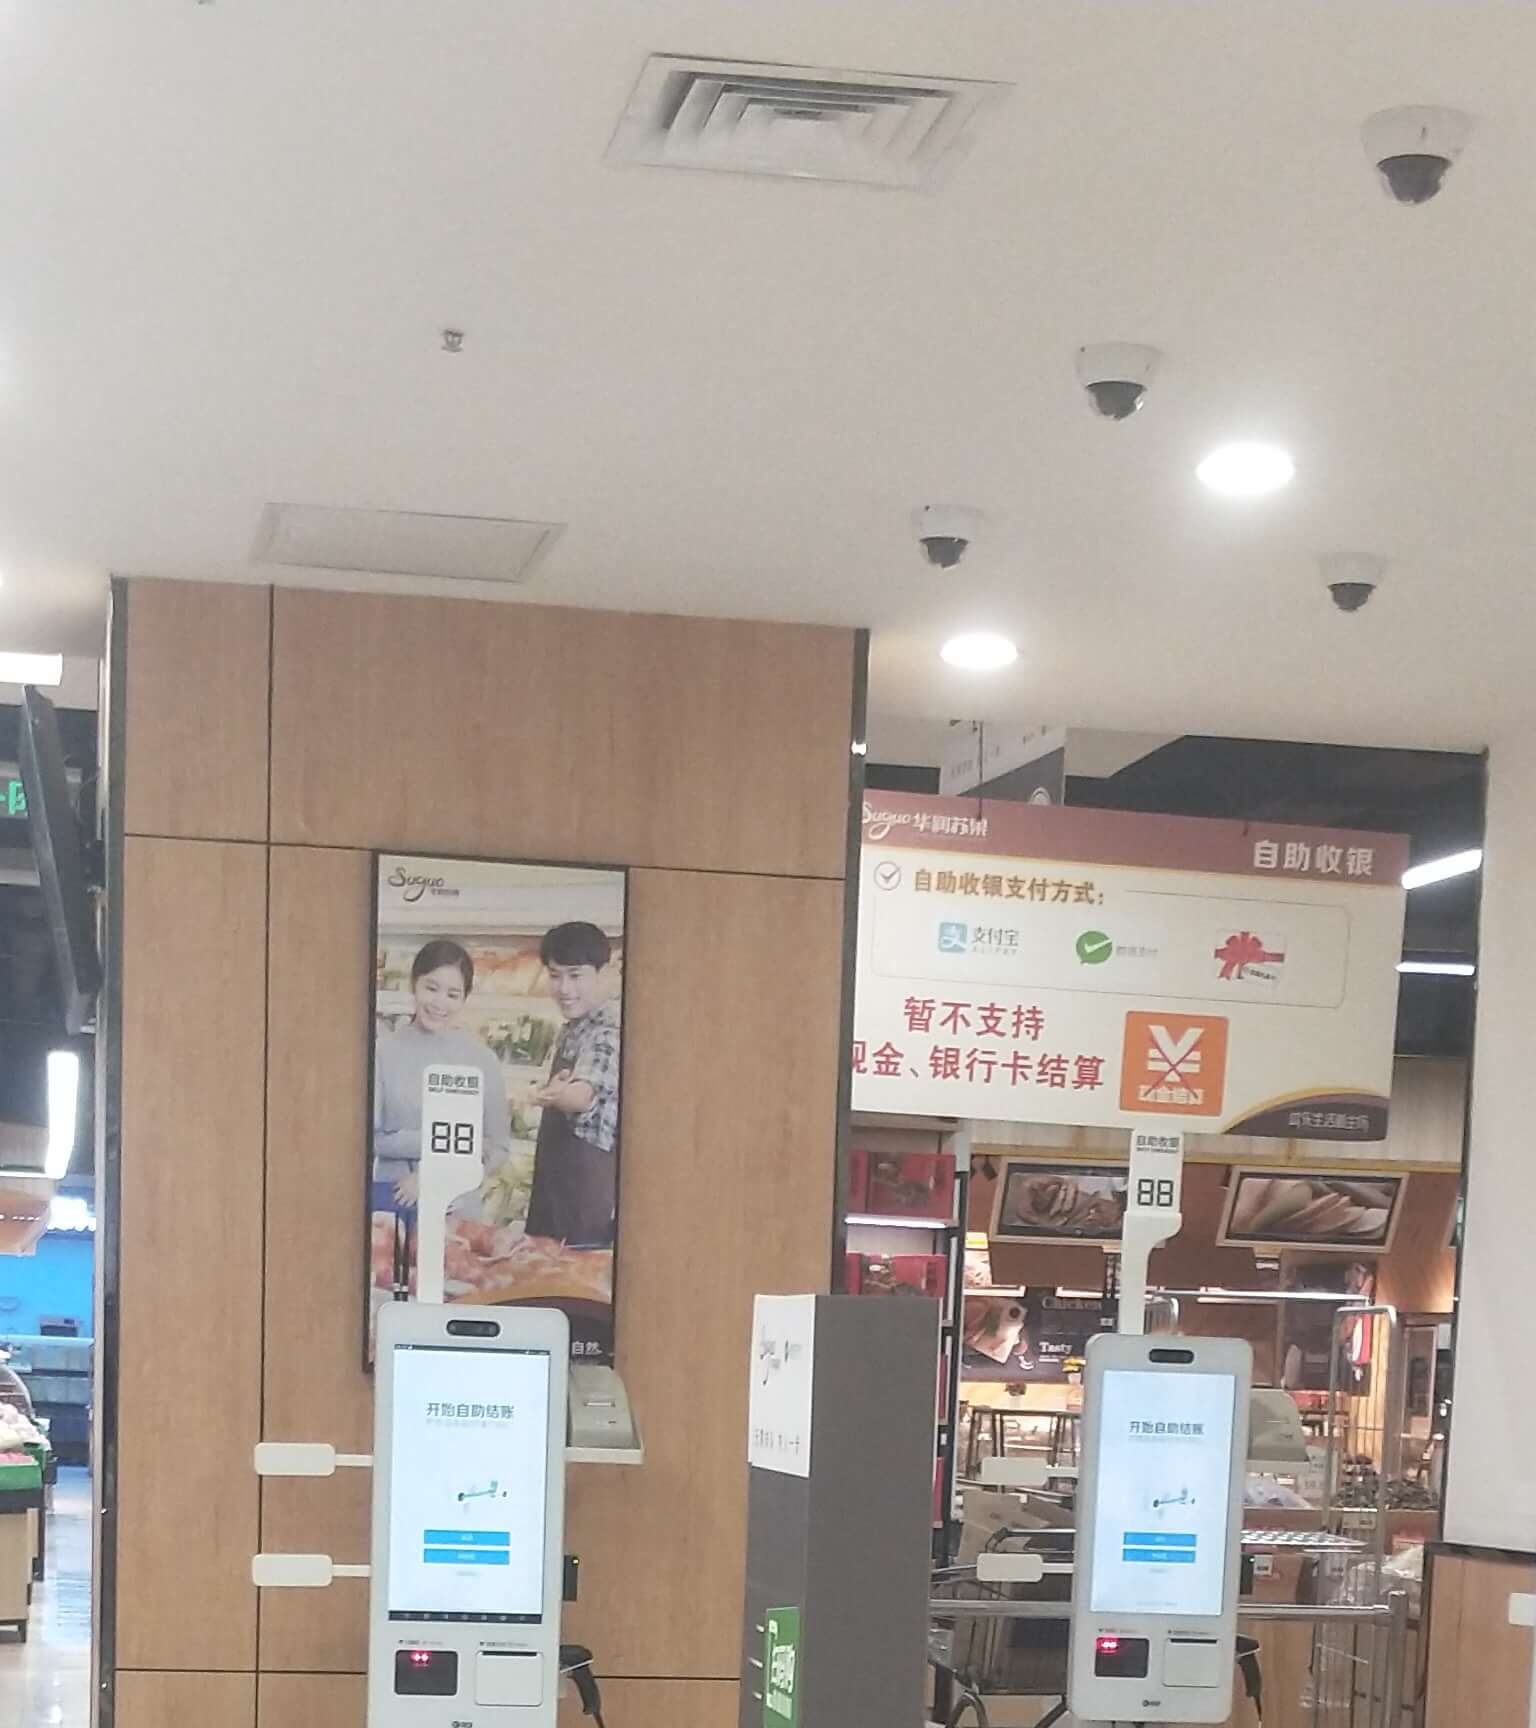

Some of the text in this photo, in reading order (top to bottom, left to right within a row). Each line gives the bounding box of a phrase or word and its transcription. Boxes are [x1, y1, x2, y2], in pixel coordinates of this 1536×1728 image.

[1252, 839, 1376, 878] 自助收银
[387, 866, 445, 902] Suguo
[971, 926, 1020, 947] 支付宝
[903, 996, 1045, 1041] 暂不支持
[431, 1121, 474, 1155] 88
[1137, 1179, 1174, 1207] 88
